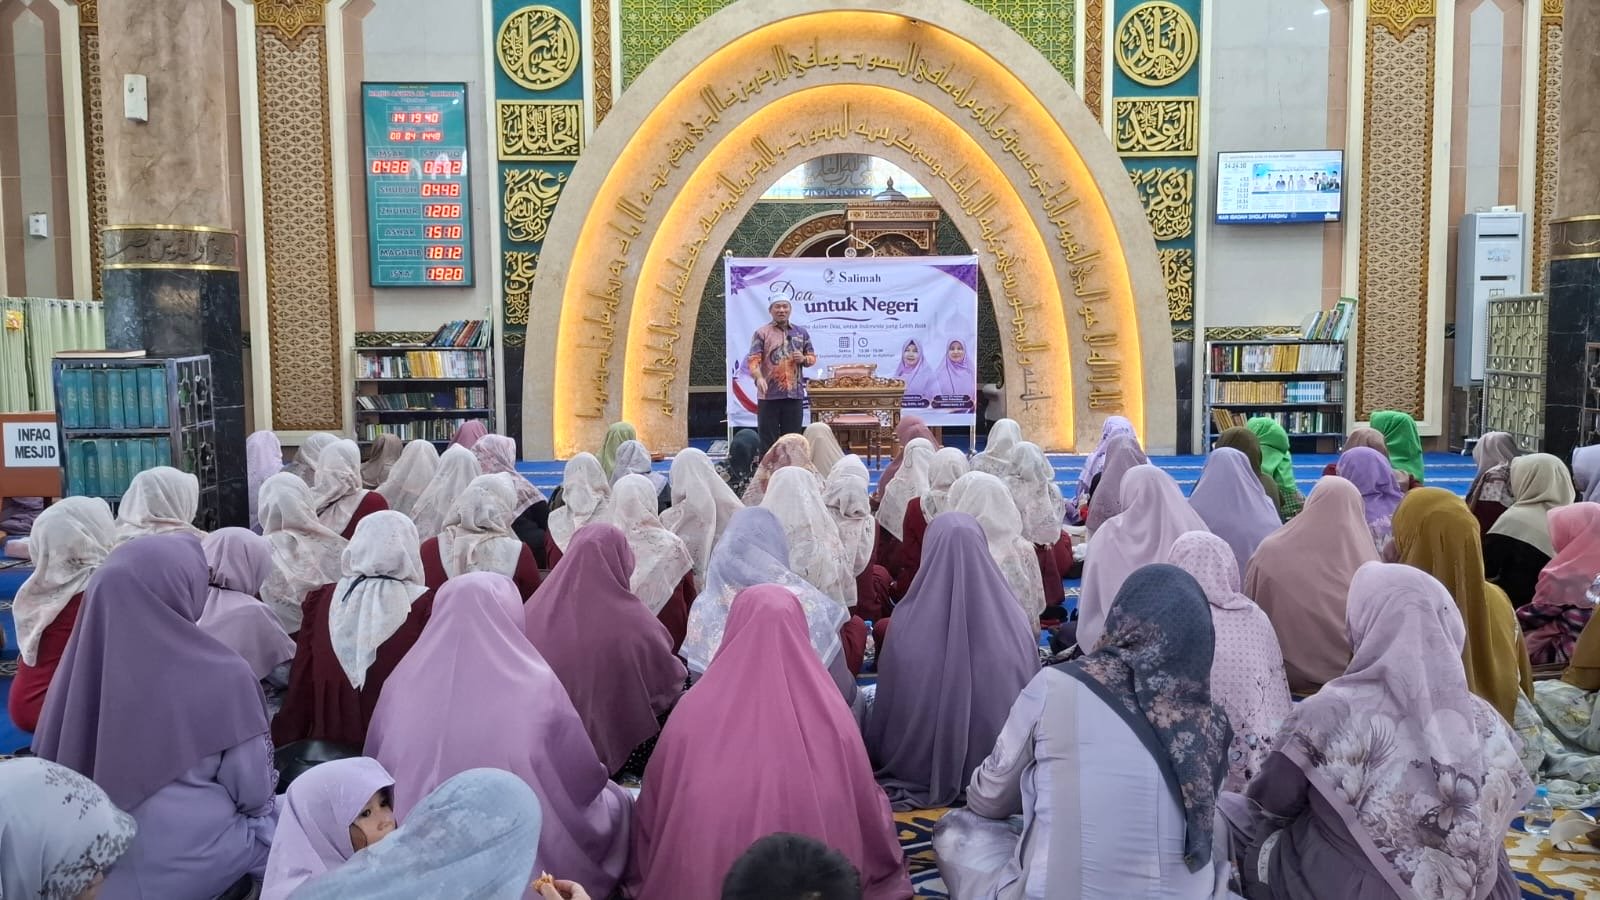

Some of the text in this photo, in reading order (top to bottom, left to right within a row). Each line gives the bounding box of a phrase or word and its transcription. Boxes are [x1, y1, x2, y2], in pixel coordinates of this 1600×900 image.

[394, 113, 439, 123] 14 19 40
[372, 160, 410, 174] 0438
[424, 160, 461, 174] 0602
[422, 184, 460, 196] 0448
[428, 205, 460, 218] 1208
[428, 226, 461, 238] 1510
[430, 247, 462, 259] 1812
[430, 268, 463, 280] 1920
[838, 272, 881, 283] Salimah
[805, 296, 919, 314] untuk Negeri
[18, 428, 51, 442] INFAQ
[15, 446, 56, 459] MESJID
